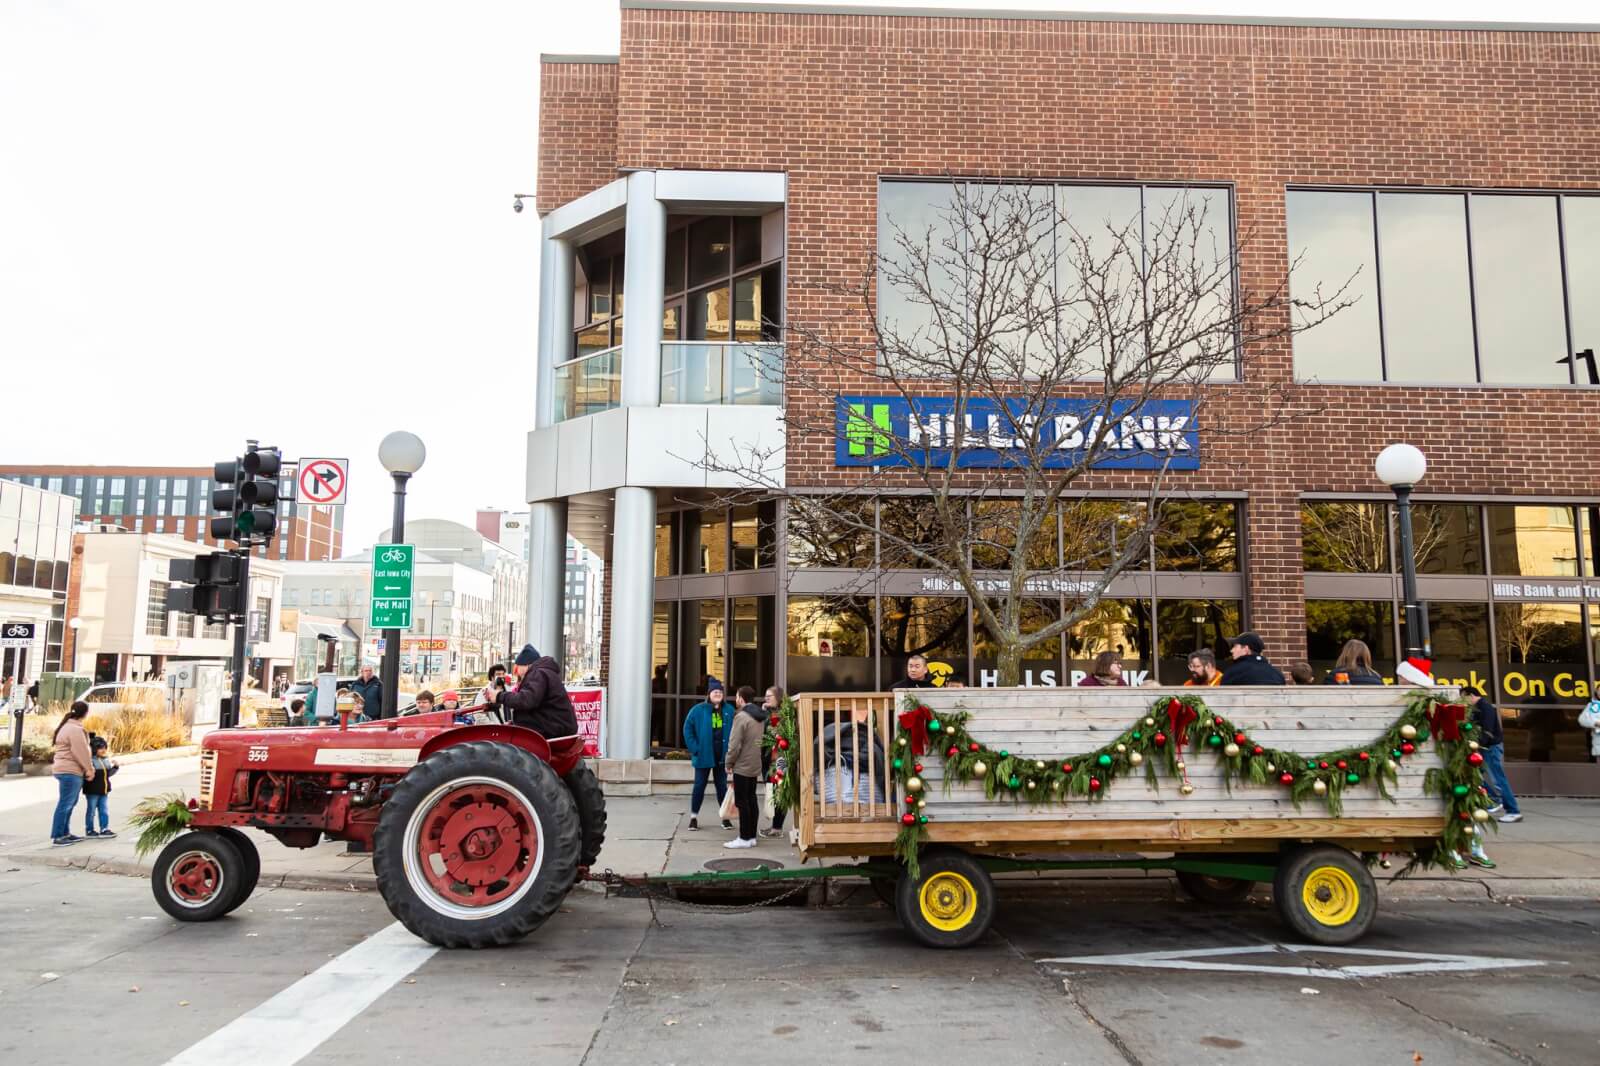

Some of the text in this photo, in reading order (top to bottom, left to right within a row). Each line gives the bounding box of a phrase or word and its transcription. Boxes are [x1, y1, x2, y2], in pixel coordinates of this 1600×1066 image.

[909, 413, 1041, 449] HILLS
[1054, 415, 1191, 449] BANK
[400, 569, 411, 579] City
[1493, 583, 1521, 597] Hills
[1523, 584, 1555, 597] Bank
[1557, 585, 1581, 598] and
[375, 600, 408, 609] Ped Mall
[416, 640, 446, 650] ARGO
[980, 669, 1057, 689] HLS
[1503, 672, 1546, 697] On
